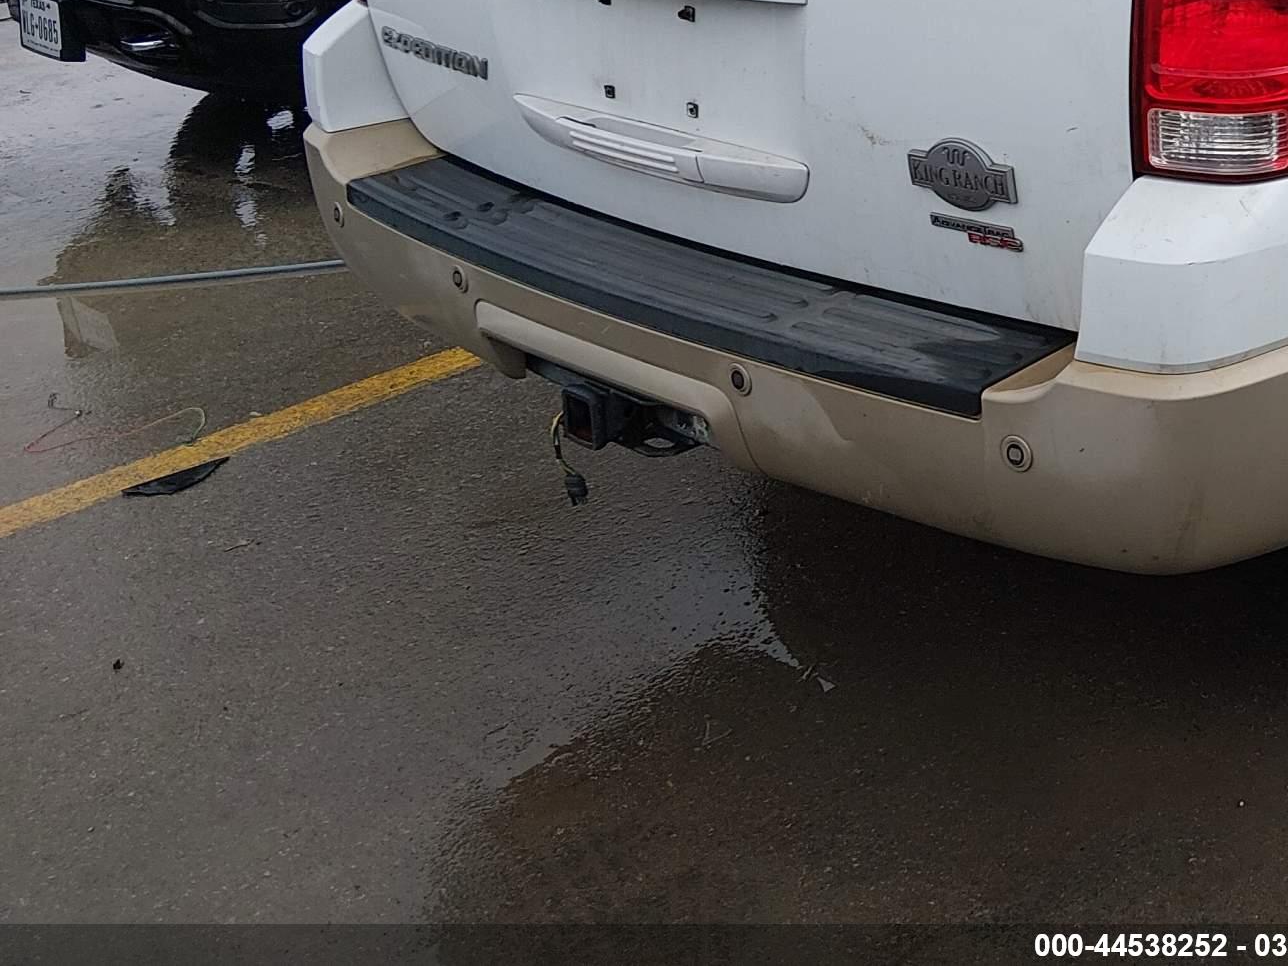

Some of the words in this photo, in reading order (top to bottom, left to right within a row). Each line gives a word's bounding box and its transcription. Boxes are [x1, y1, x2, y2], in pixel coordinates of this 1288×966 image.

[381, 25, 489, 81] EXPEDITION
[911, 160, 950, 188] KING
[952, 170, 1006, 196] RANCH
